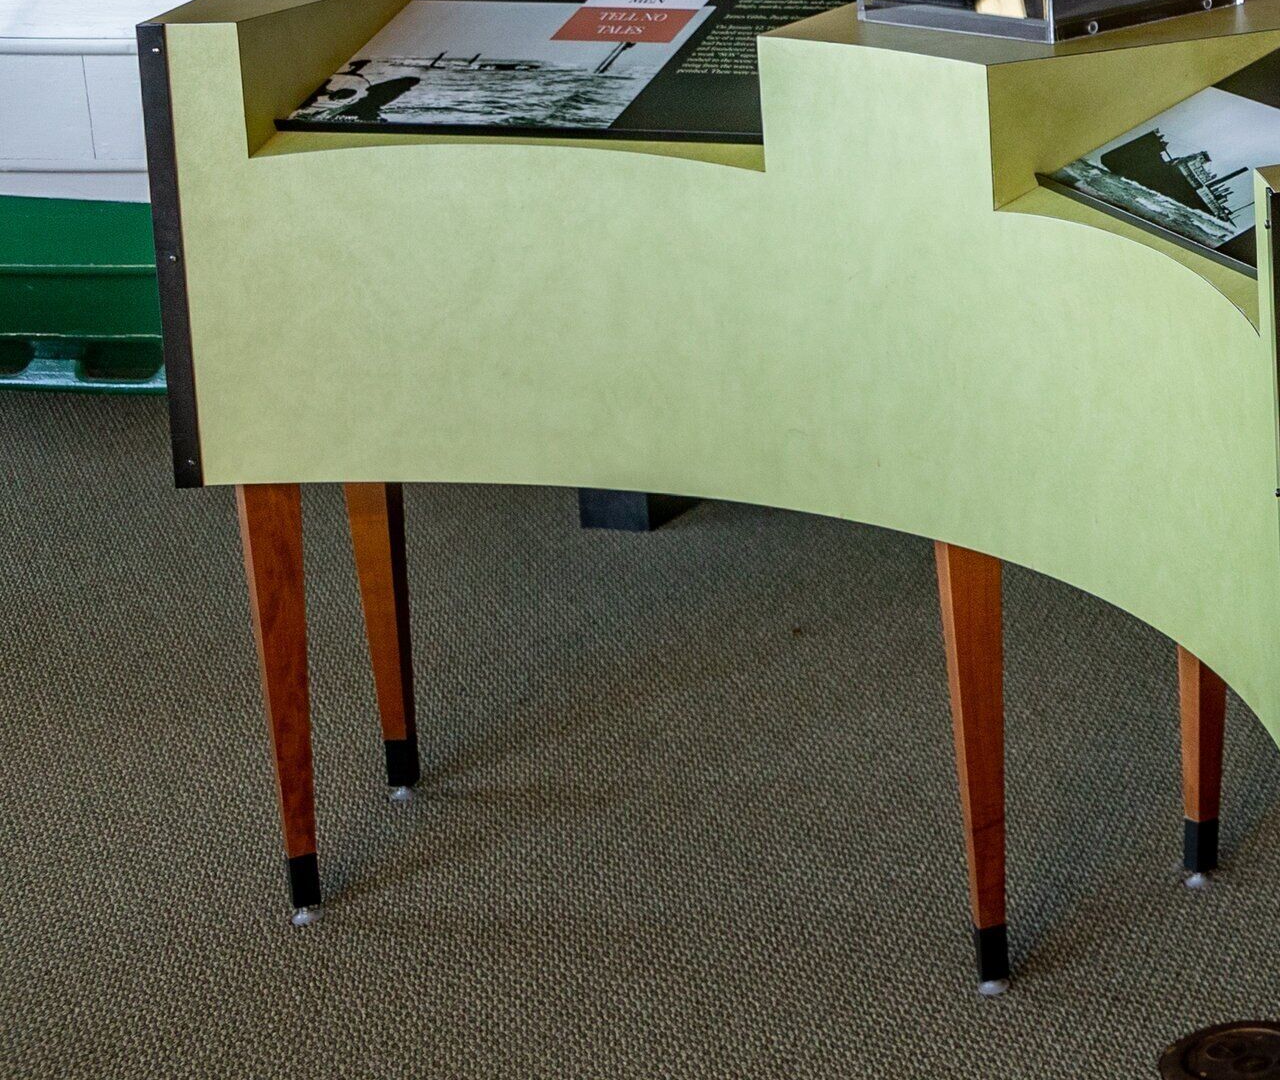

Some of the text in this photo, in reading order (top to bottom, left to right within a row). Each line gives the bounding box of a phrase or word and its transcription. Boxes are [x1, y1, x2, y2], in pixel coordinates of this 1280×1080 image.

[599, 11, 669, 22] TELL NO
[596, 25, 646, 35] TALES
